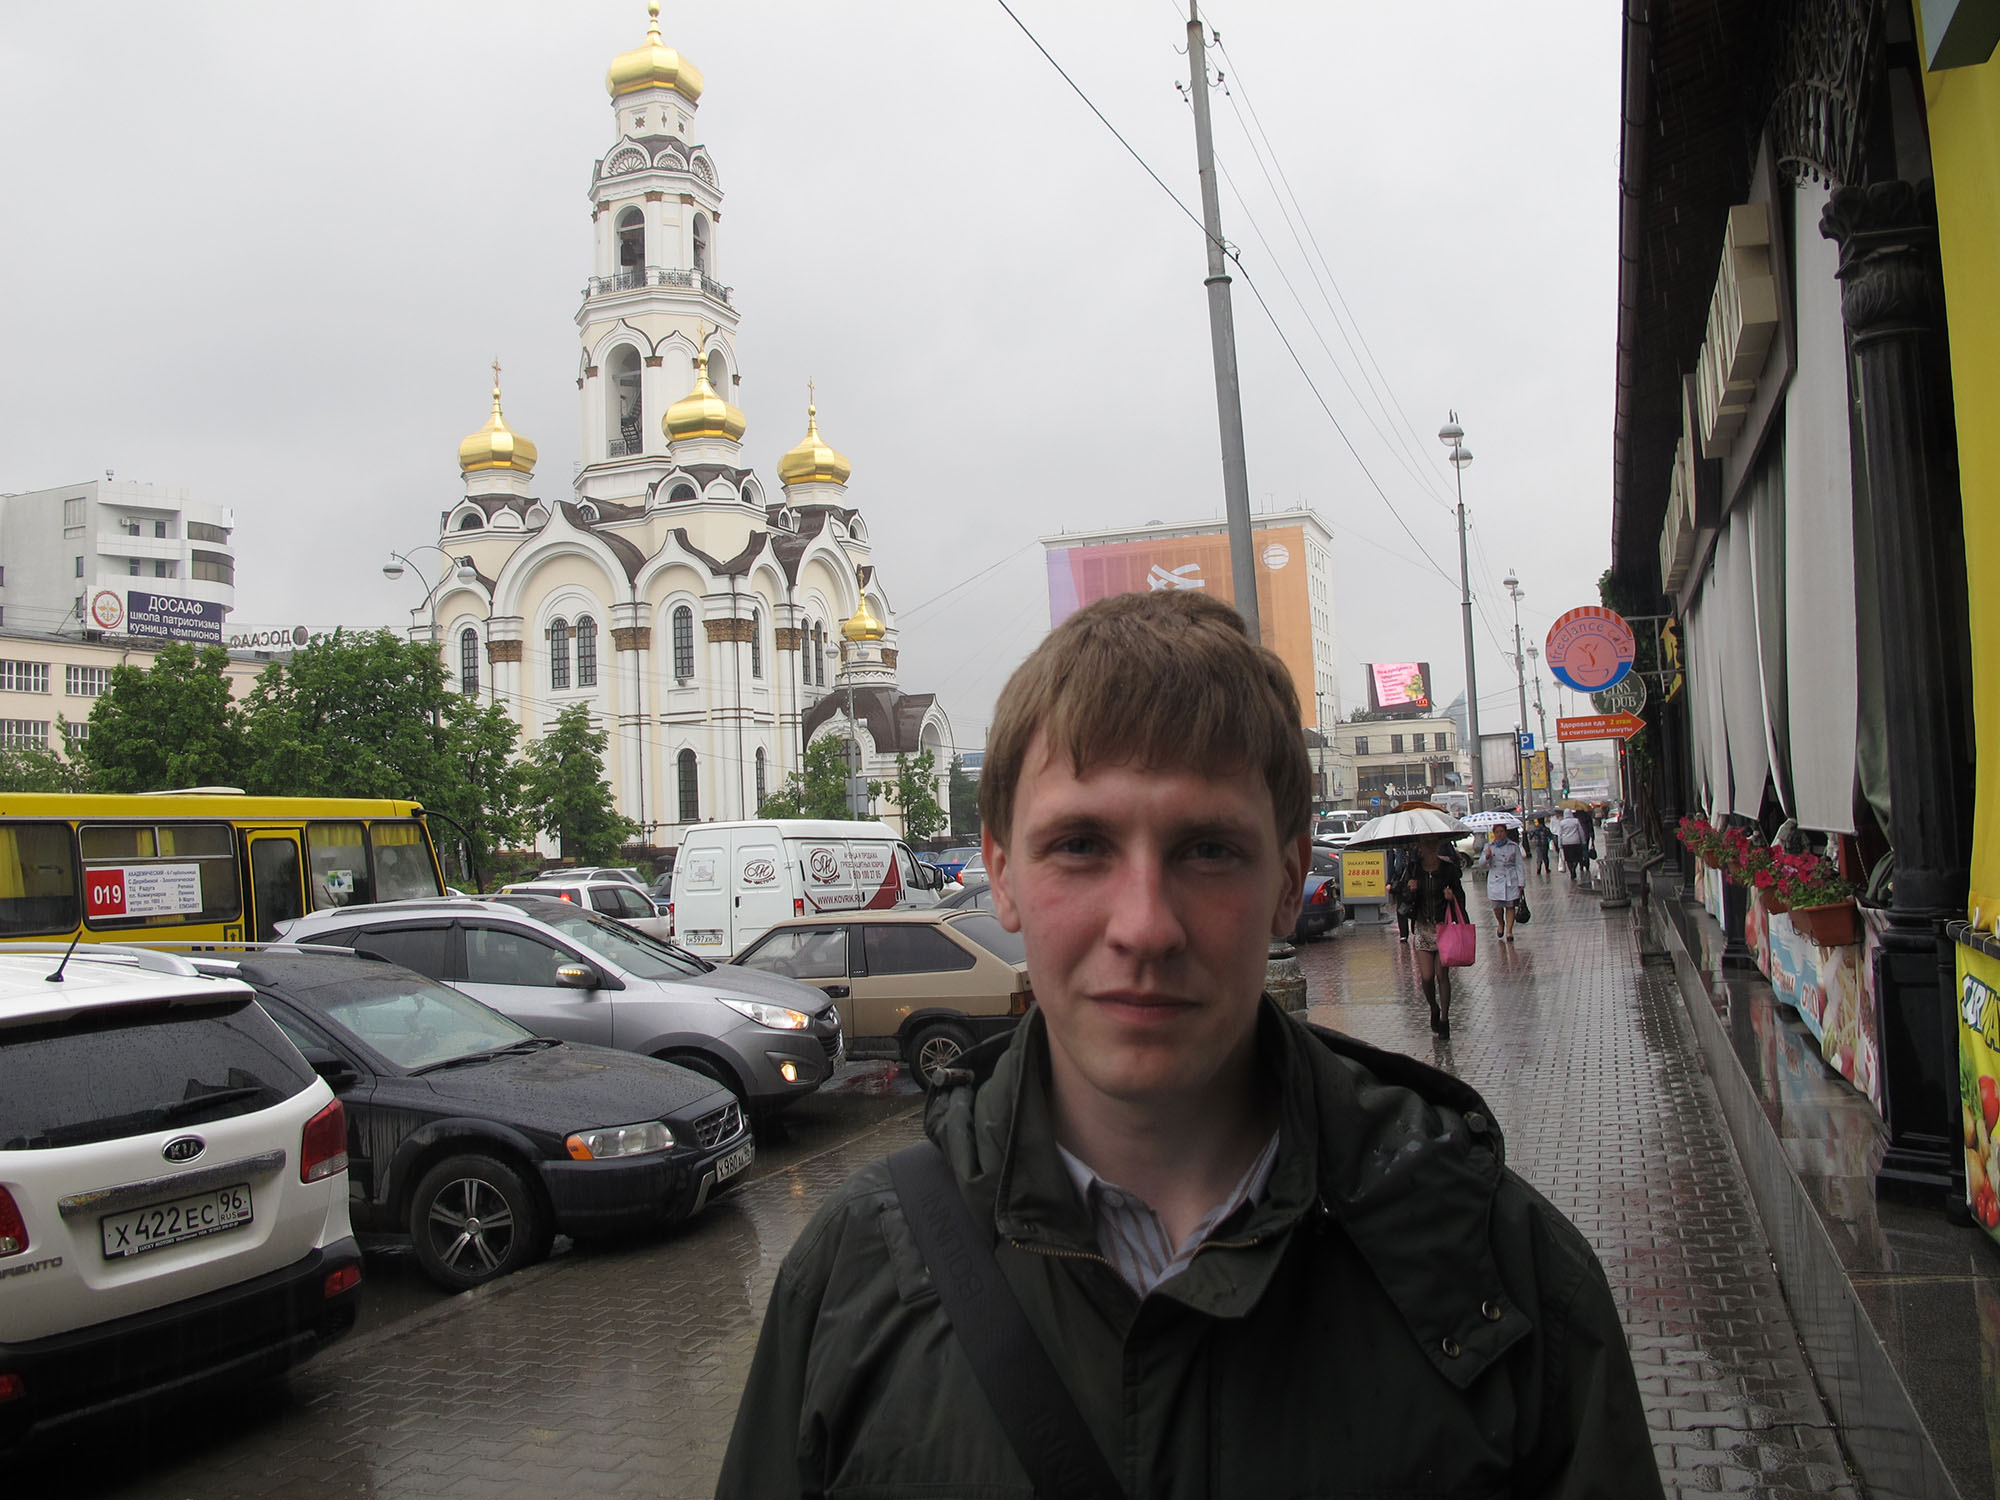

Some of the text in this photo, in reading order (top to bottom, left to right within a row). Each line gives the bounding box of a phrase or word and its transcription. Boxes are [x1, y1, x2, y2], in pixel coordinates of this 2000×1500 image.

[148, 595, 204, 615] ДОСААФ
[130, 611, 220, 630] школа патриотизма
[129, 622, 220, 641] кузница чемпионов
[1550, 622, 1604, 660] freelance
[1560, 721, 1592, 729] Здоровая
[1569, 728, 1605, 736] считанные
[94, 884, 122, 904] 019
[170, 1141, 199, 1159] KIA
[220, 1190, 242, 1212] 96
[221, 1212, 237, 1222] RUS
[0, 1256, 63, 1279] RENTO
